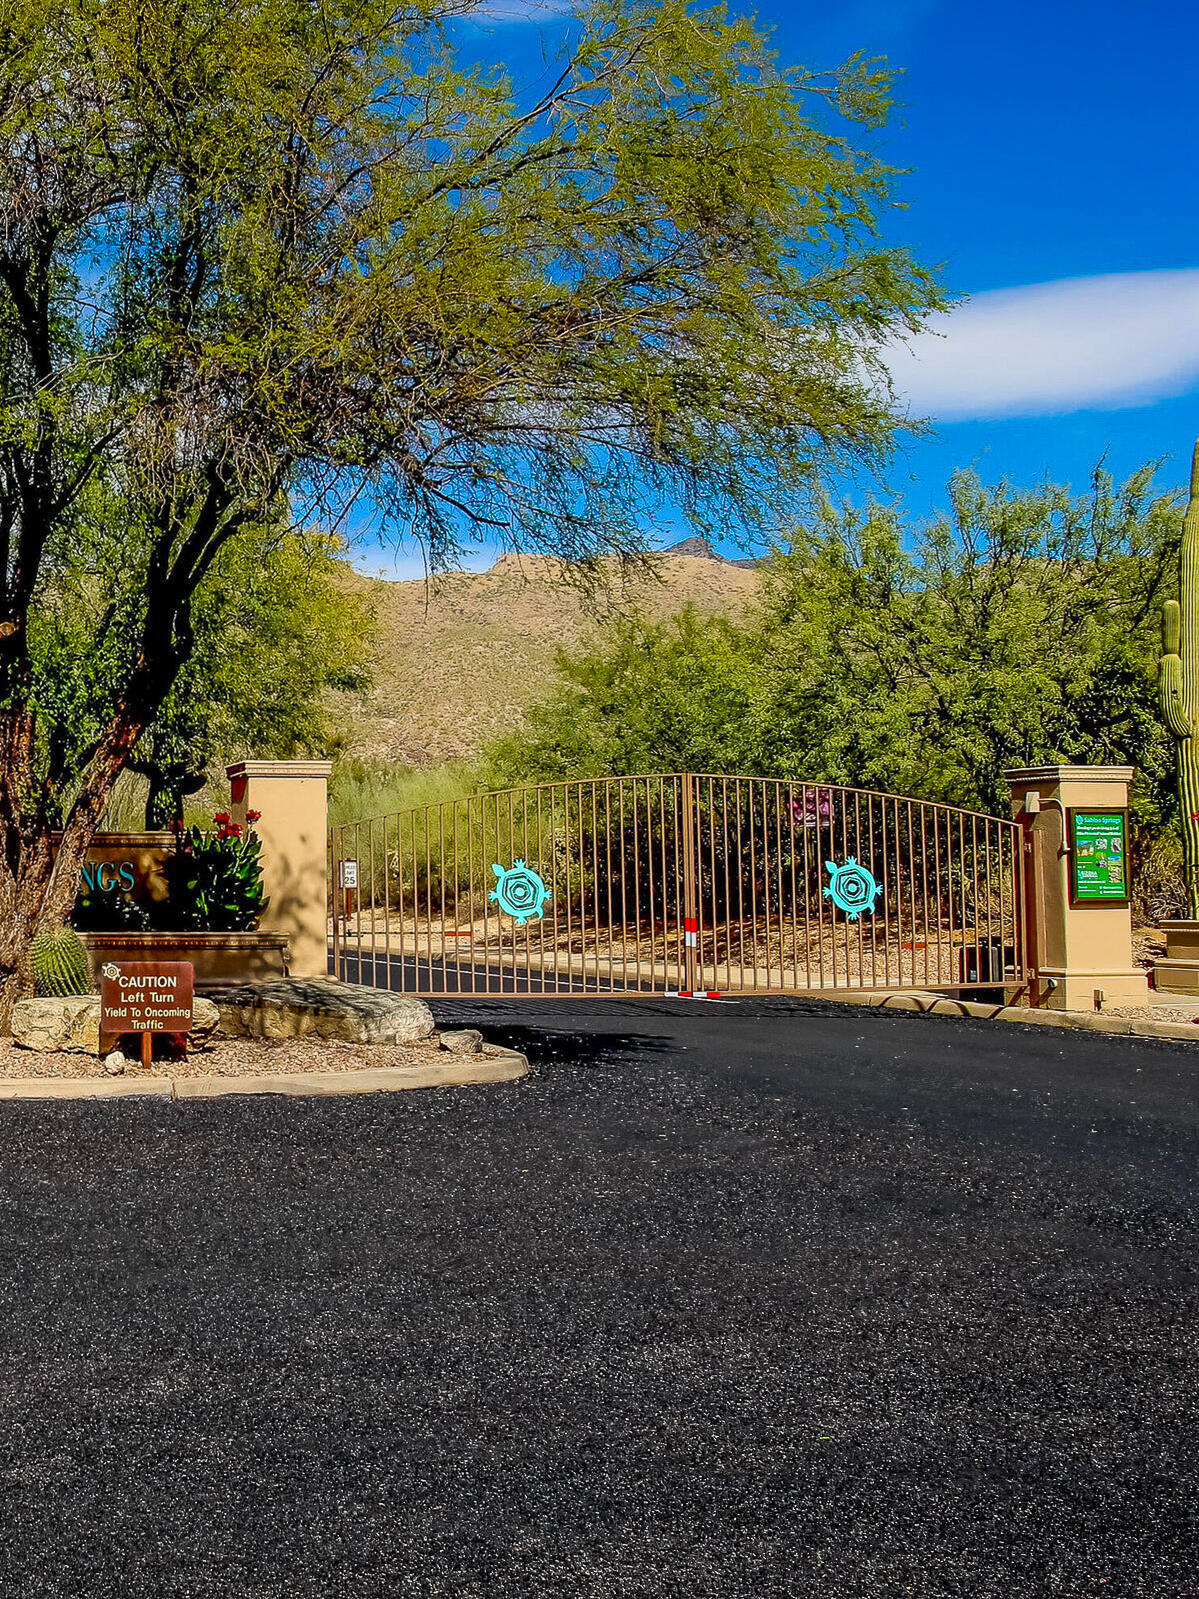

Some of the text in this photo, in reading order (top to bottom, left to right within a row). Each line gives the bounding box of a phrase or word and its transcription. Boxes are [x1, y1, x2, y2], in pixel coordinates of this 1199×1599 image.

[345, 876, 355, 885] 25
[118, 976, 176, 988] CAUTION
[121, 991, 174, 1003] Left Turn
[104, 1006, 191, 1019] Yield To Oncoming
[131, 1020, 164, 1030] Traffic
